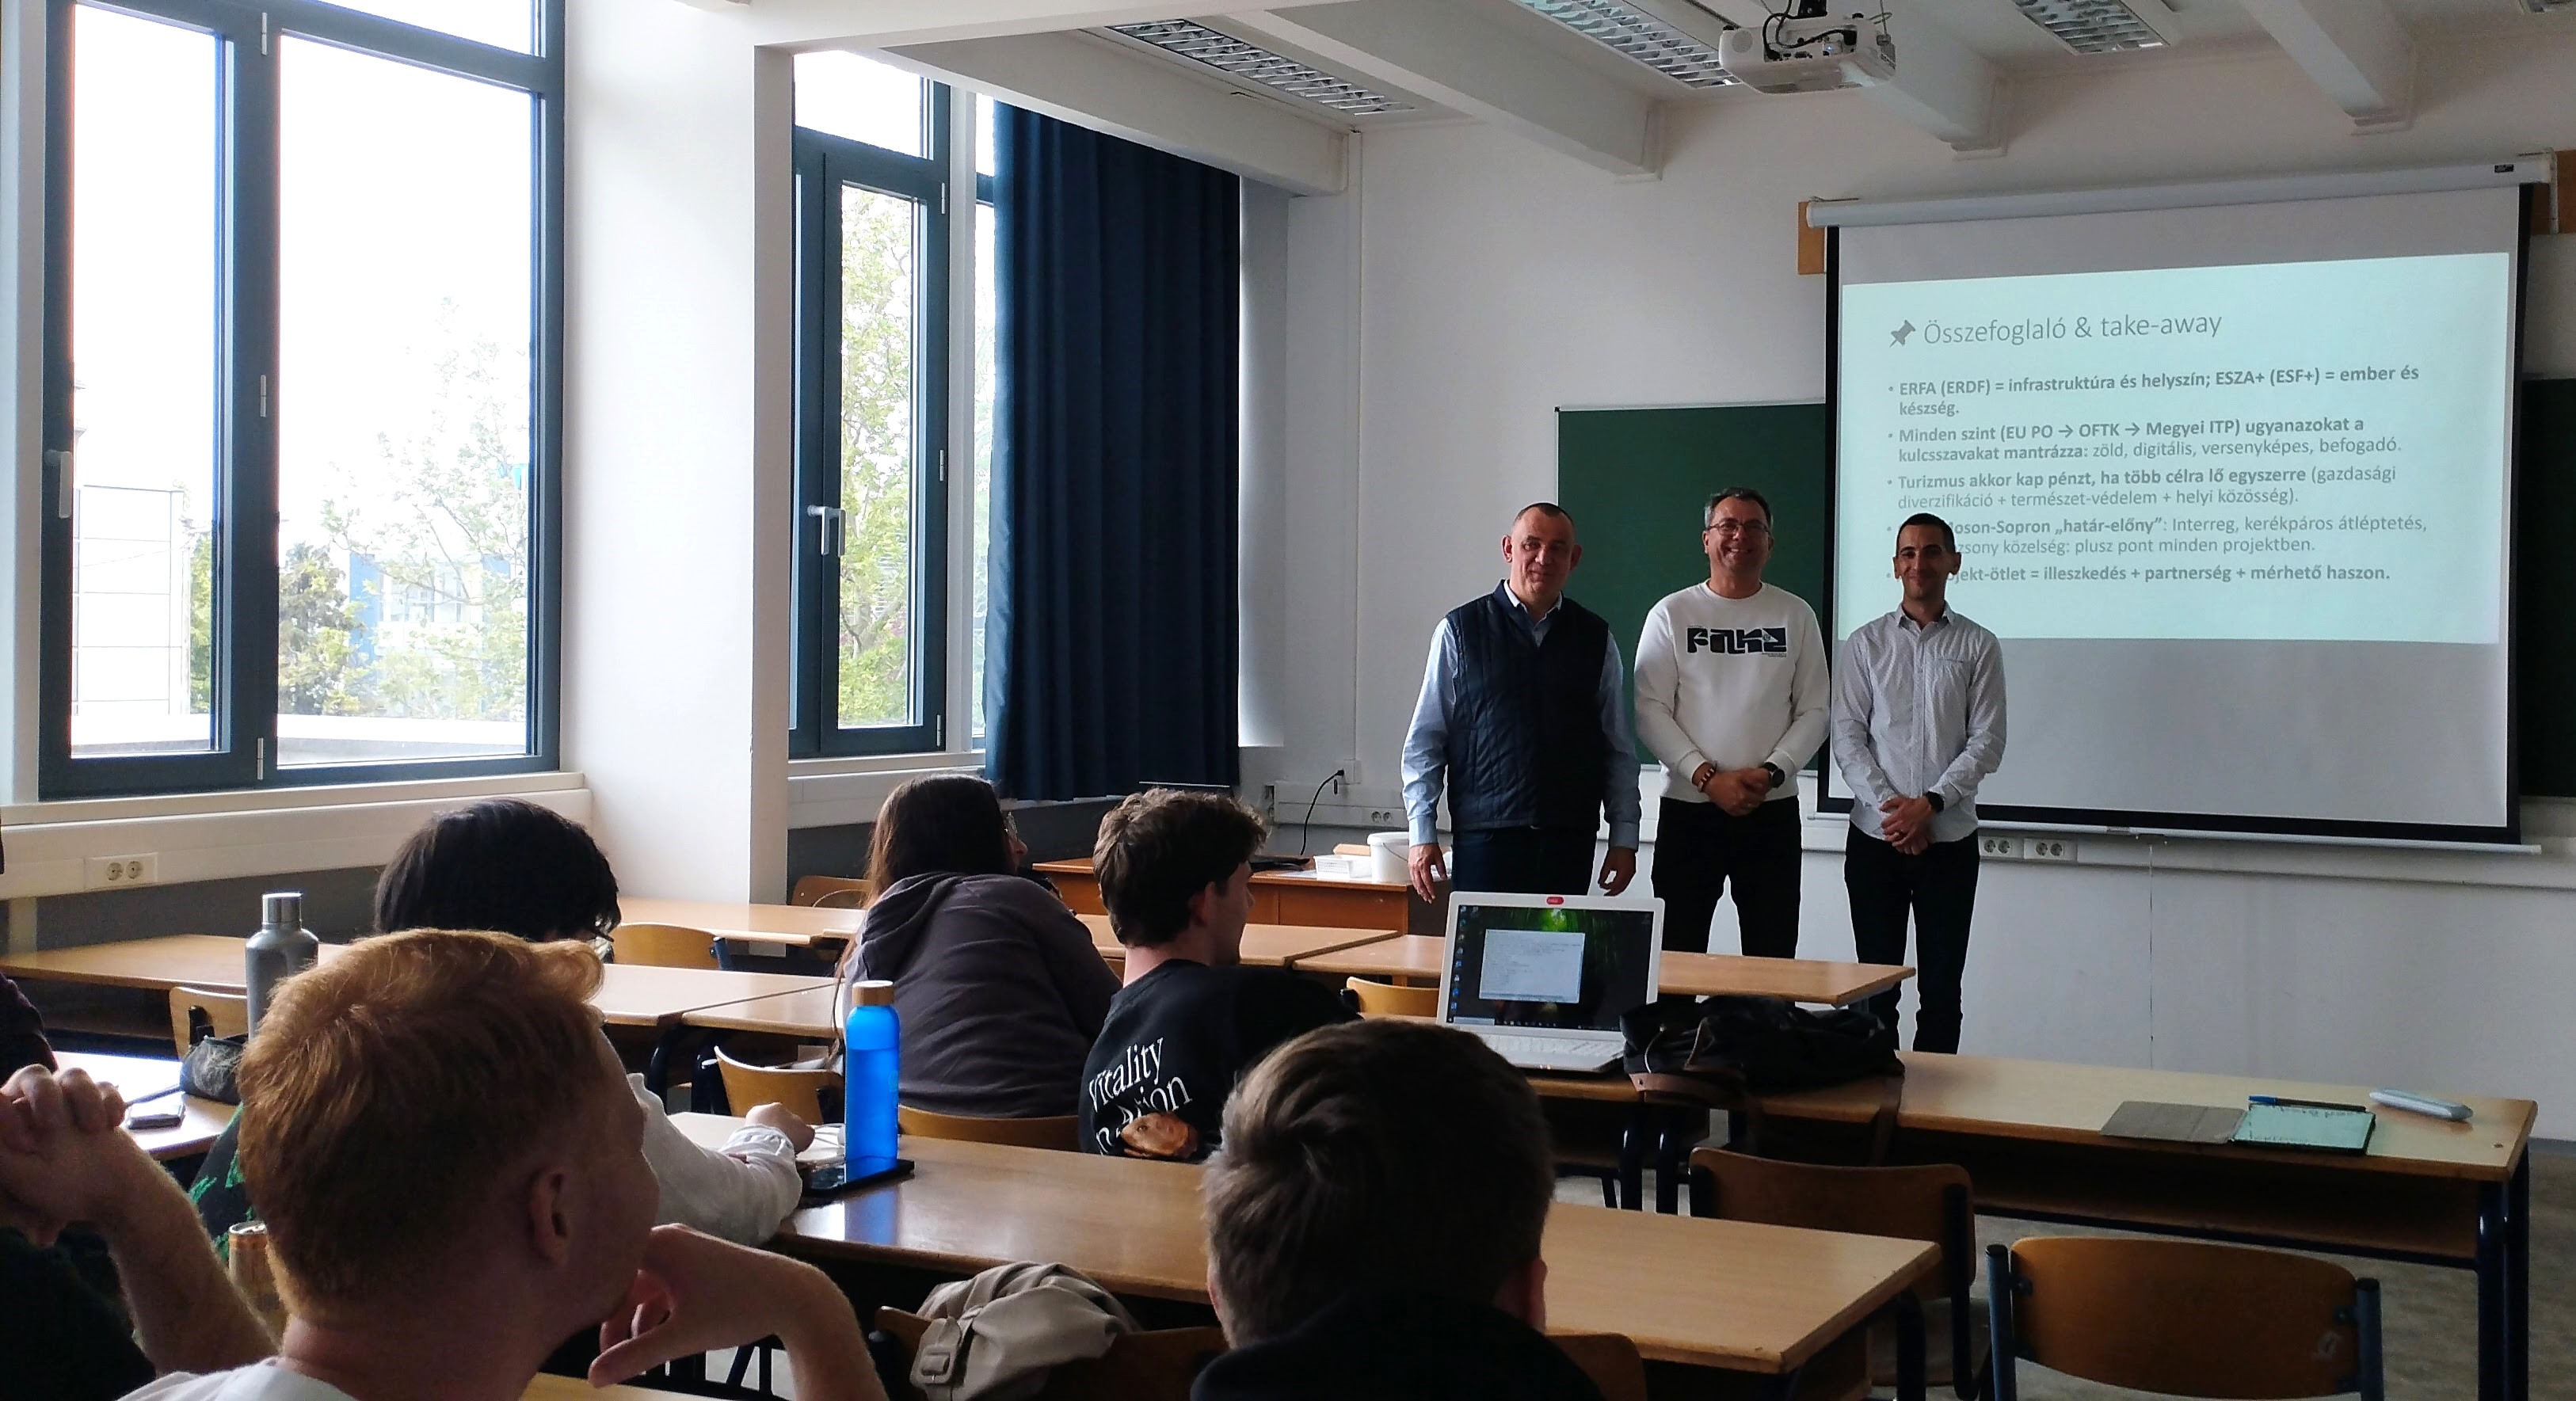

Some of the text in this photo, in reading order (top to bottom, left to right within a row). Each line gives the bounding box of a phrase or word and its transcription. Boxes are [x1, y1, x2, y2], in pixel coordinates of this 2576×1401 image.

[1924, 314, 2222, 346] Összefoglaló & take-away
[1900, 382, 1937, 395] ERFA
[1941, 379, 1991, 397] (ERDF)
[2009, 375, 2115, 393] infrastruktúra
[2120, 375, 2136, 388] és
[2142, 371, 2211, 390] helyszín;
[2216, 371, 2265, 385] ESZA+
[2269, 367, 2320, 386] (ESF+)
[2339, 365, 2395, 381] ember
[2400, 364, 2419, 380] és
[1900, 402, 1960, 417] készség.
[1900, 417, 2364, 443] Minden szint (EU PO OFTK Megyei ITP) ugyanazokat a
[1899, 436, 2402, 463] kulcsszavakat mantrázza: zöld, digitális, versenyképes, befogadó.
[1899, 466, 2396, 489] Turizmus akkor kap pénzt, ha több célra lő egyszerre (gazdasági
[1898, 493, 1993, 509] diverzifikáció
[2010, 490, 2157, 507] természet-védelem
[2176, 489, 2213, 505] helyi
[2218, 487, 2299, 505] közösség).
[2173, 517, 2239, 533] Interreg,
[2245, 516, 2333, 533] kerékpáros
[2338, 515, 2427, 533] átléptetés,
[2003, 539, 2069, 557] közelség:
[2075, 536, 2113, 554] plusz
[2118, 538, 2153, 554] pont
[2159, 538, 2217, 552] minden
[2224, 538, 2315, 555] projektben.
[2044, 565, 2126, 581] illeszkedés
[2145, 565, 2231, 583] partnerség
[2236, 569, 2246, 578] +
[2251, 564, 2322, 580] mérhető
[2327, 565, 2391, 580] haszon.
